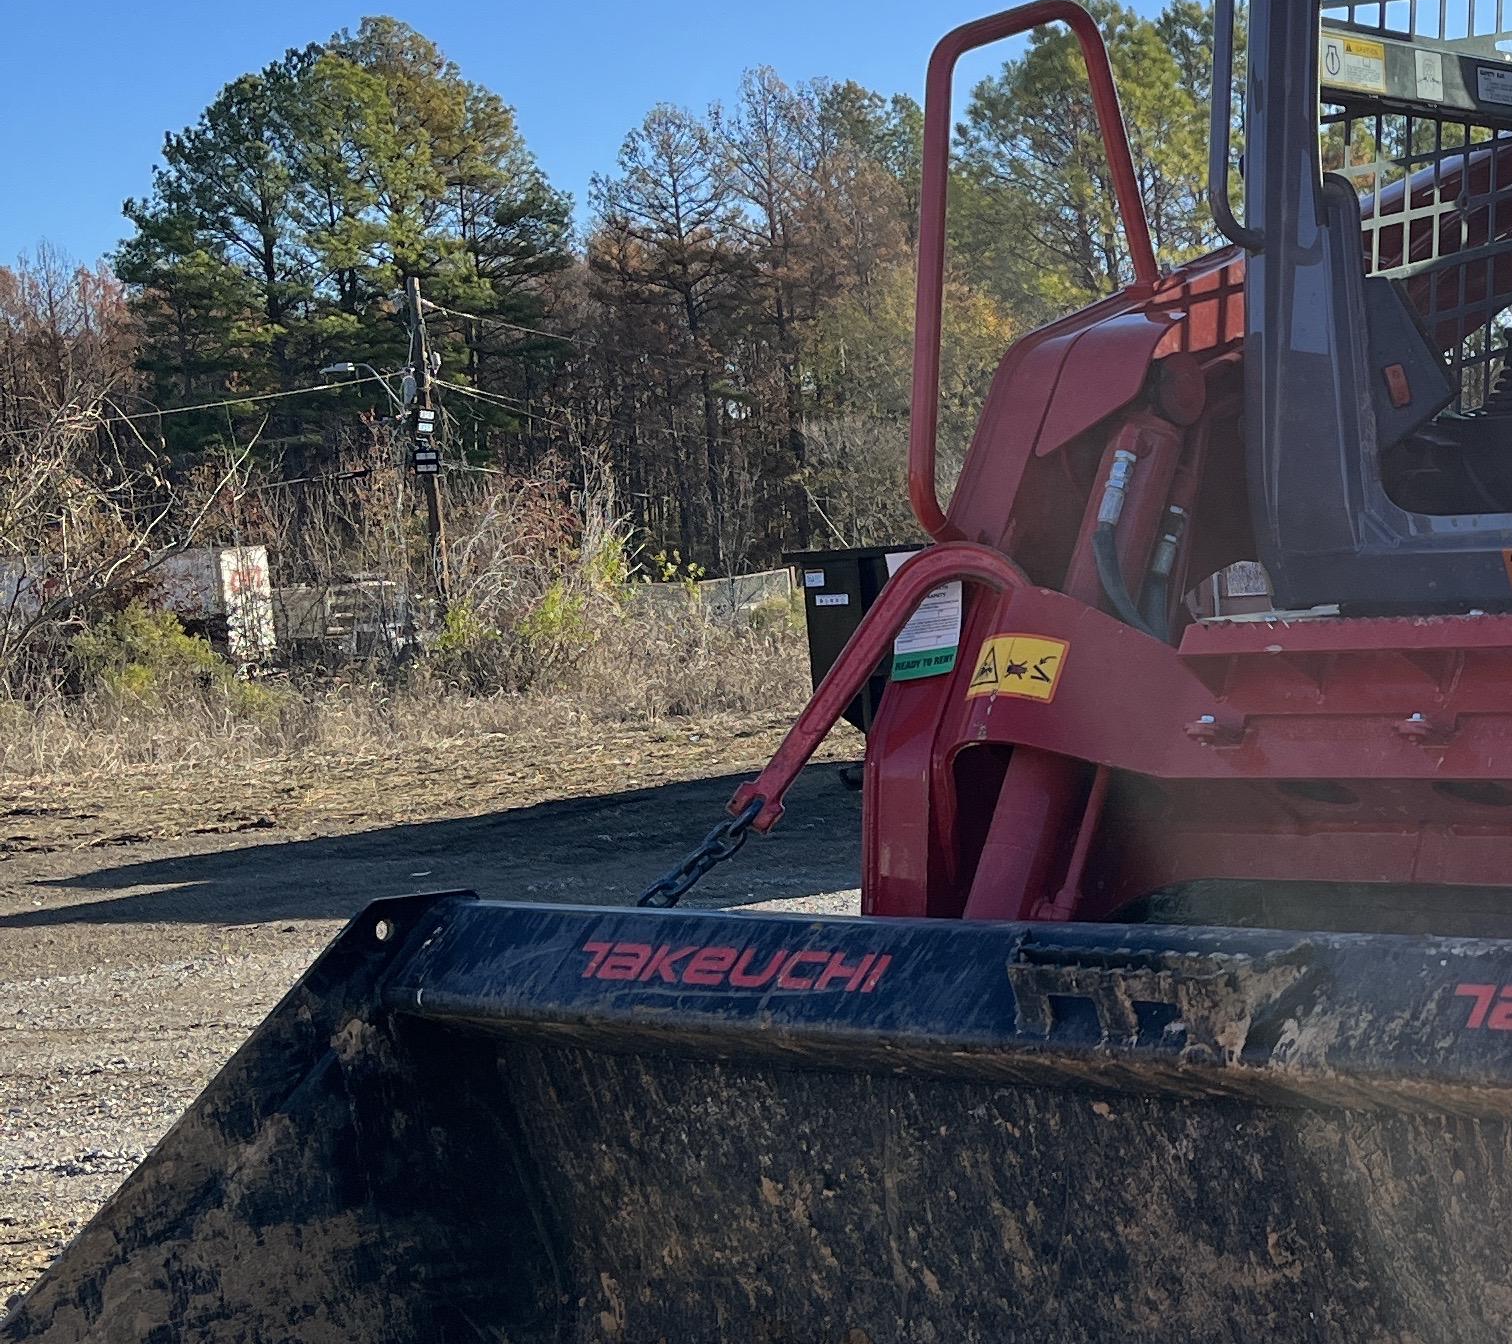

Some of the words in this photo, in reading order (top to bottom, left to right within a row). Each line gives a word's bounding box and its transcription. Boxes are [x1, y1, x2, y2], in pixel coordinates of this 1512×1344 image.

[894, 658, 920, 671] READY
[923, 657, 932, 668] TO
[934, 655, 955, 666] RENT
